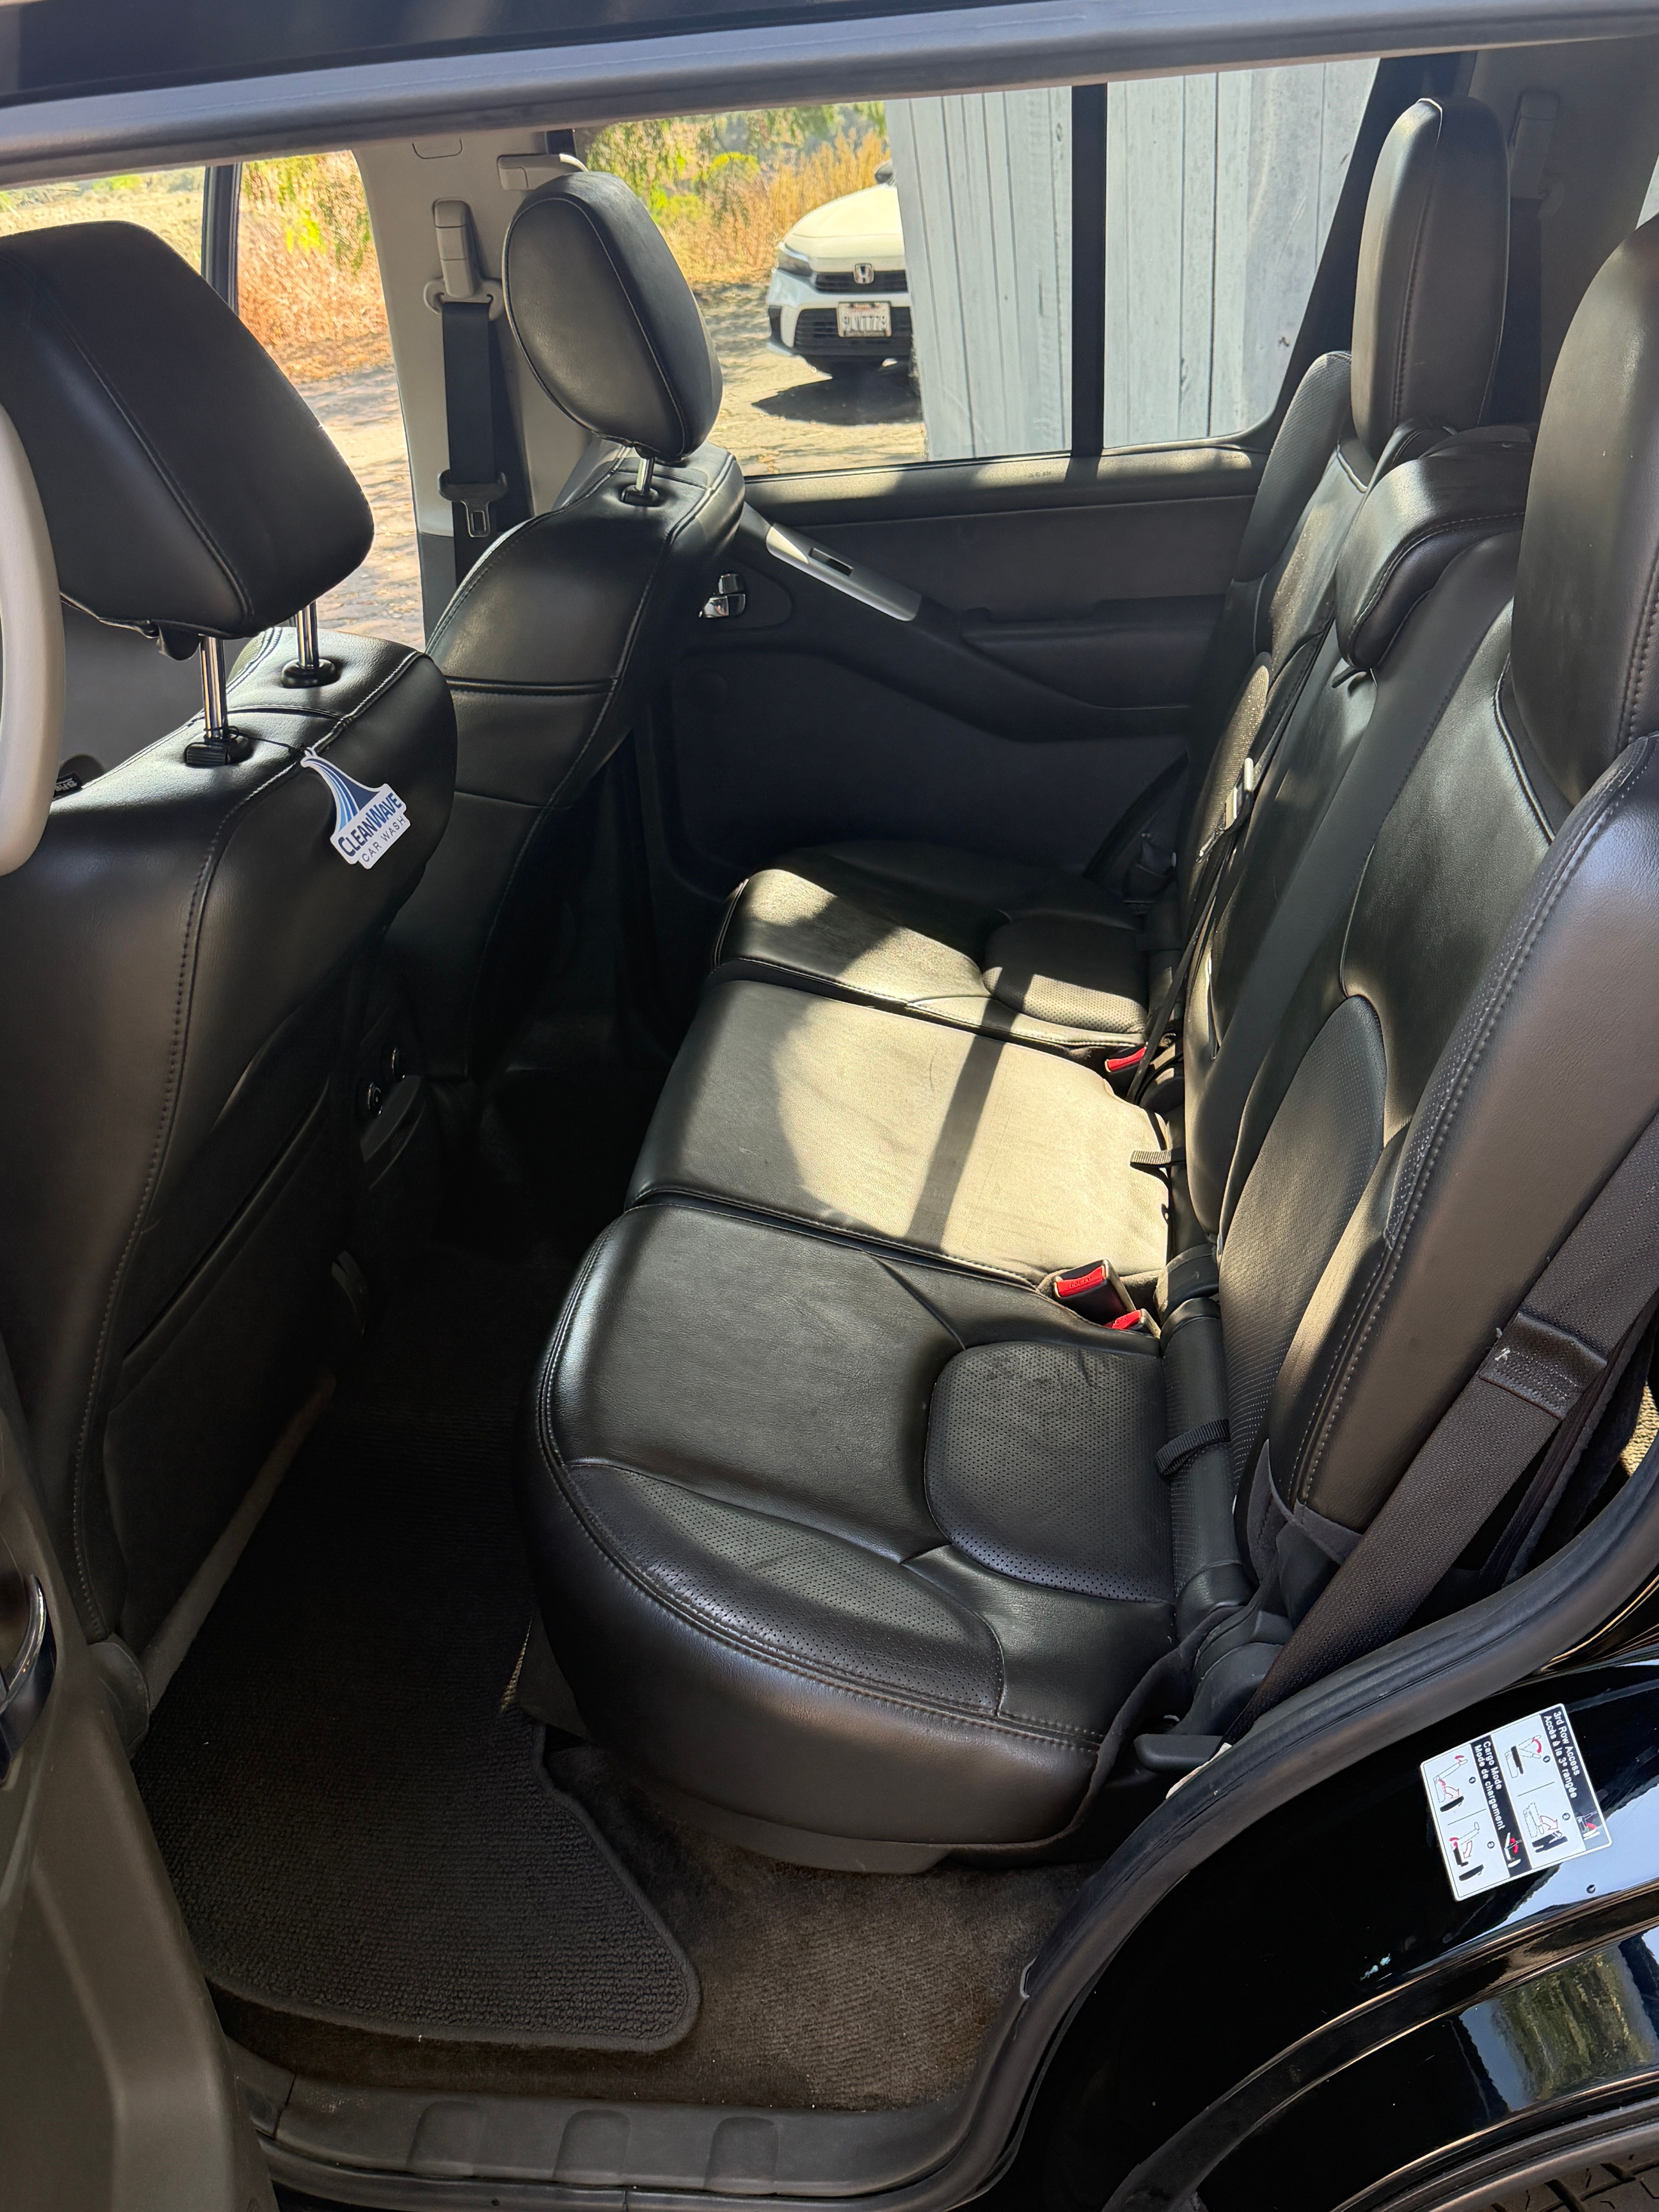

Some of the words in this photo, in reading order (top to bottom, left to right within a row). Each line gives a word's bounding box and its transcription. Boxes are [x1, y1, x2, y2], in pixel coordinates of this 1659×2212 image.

[338, 792, 402, 857] CLEANWAVE
[362, 842, 382, 862] CAR
[380, 816, 405, 842] WASH
[1553, 1711, 1564, 1725] 3rd
[1558, 1726, 1569, 1744] Row
[1483, 1741, 1494, 1765] Cargo
[1491, 1766, 1502, 1790] Mode
[1554, 1747, 1562, 1757] la
[1562, 1769, 1577, 1798] rangée
[1565, 1746, 1580, 1776] Access
[1474, 1744, 1486, 1767] Mode
[1481, 1769, 1489, 1779] de
[1485, 1781, 1505, 1830] chargement
